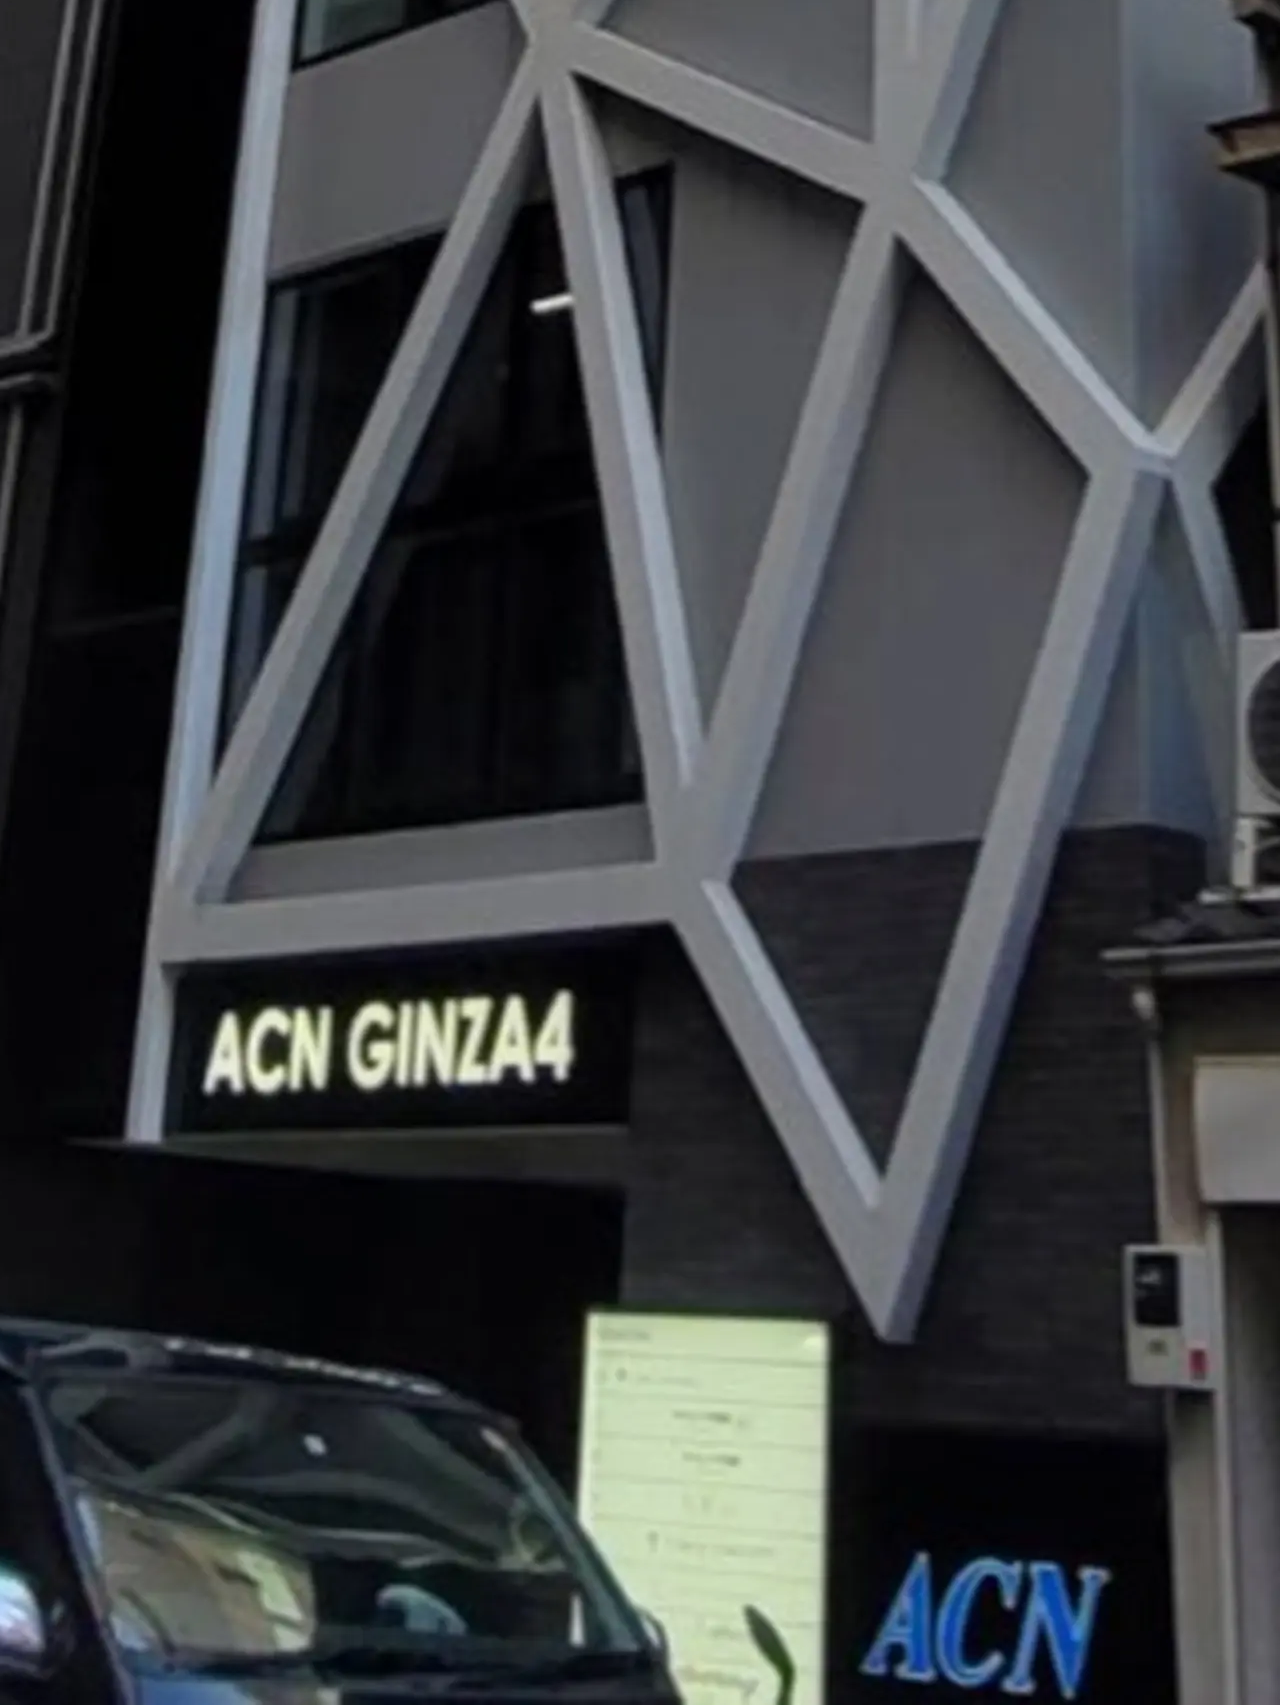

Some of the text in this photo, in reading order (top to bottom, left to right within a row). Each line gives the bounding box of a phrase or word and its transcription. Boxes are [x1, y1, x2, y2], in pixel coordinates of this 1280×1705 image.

[203, 989, 574, 1094] ACN GINZA4
[858, 1550, 1112, 1700] ACN
